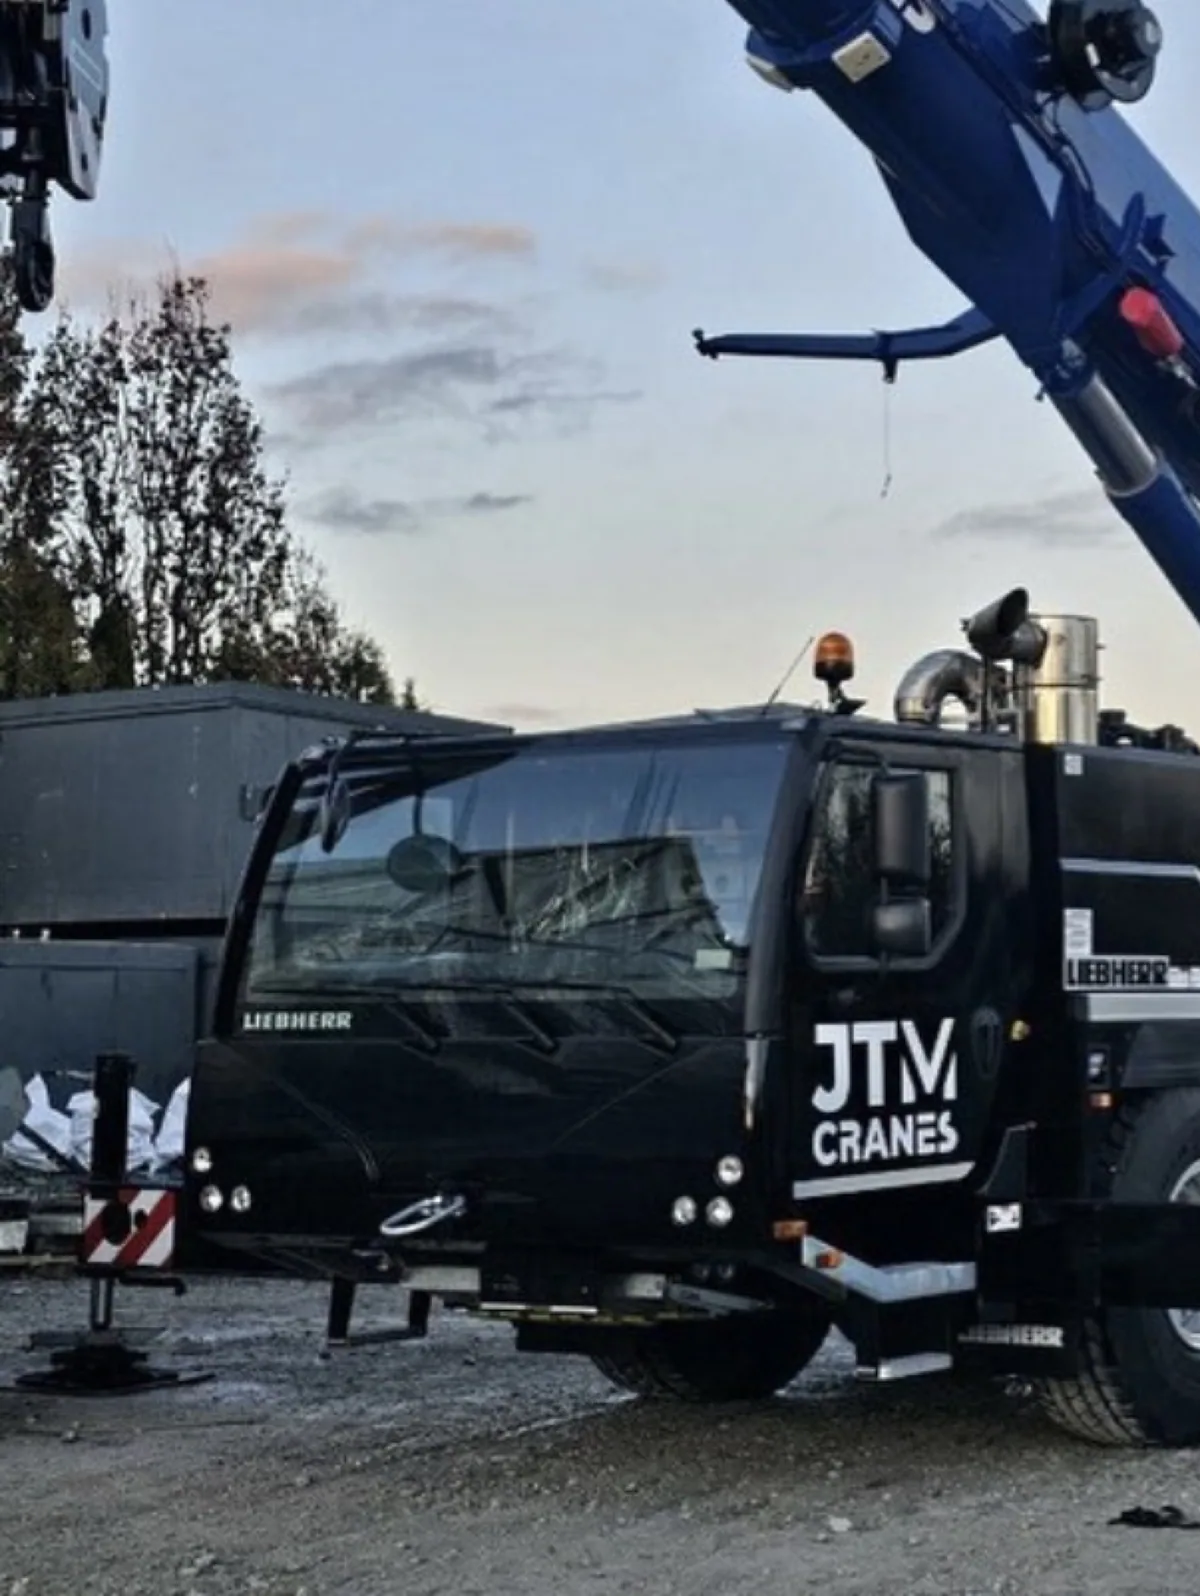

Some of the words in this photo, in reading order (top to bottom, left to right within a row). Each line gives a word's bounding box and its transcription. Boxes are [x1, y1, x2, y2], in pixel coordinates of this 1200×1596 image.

[1068, 958, 1167, 985] LIEBHERR
[243, 1011, 352, 1031] LIEBHERR
[811, 1017, 957, 1113] JTM
[811, 1111, 959, 1166] CRANES
